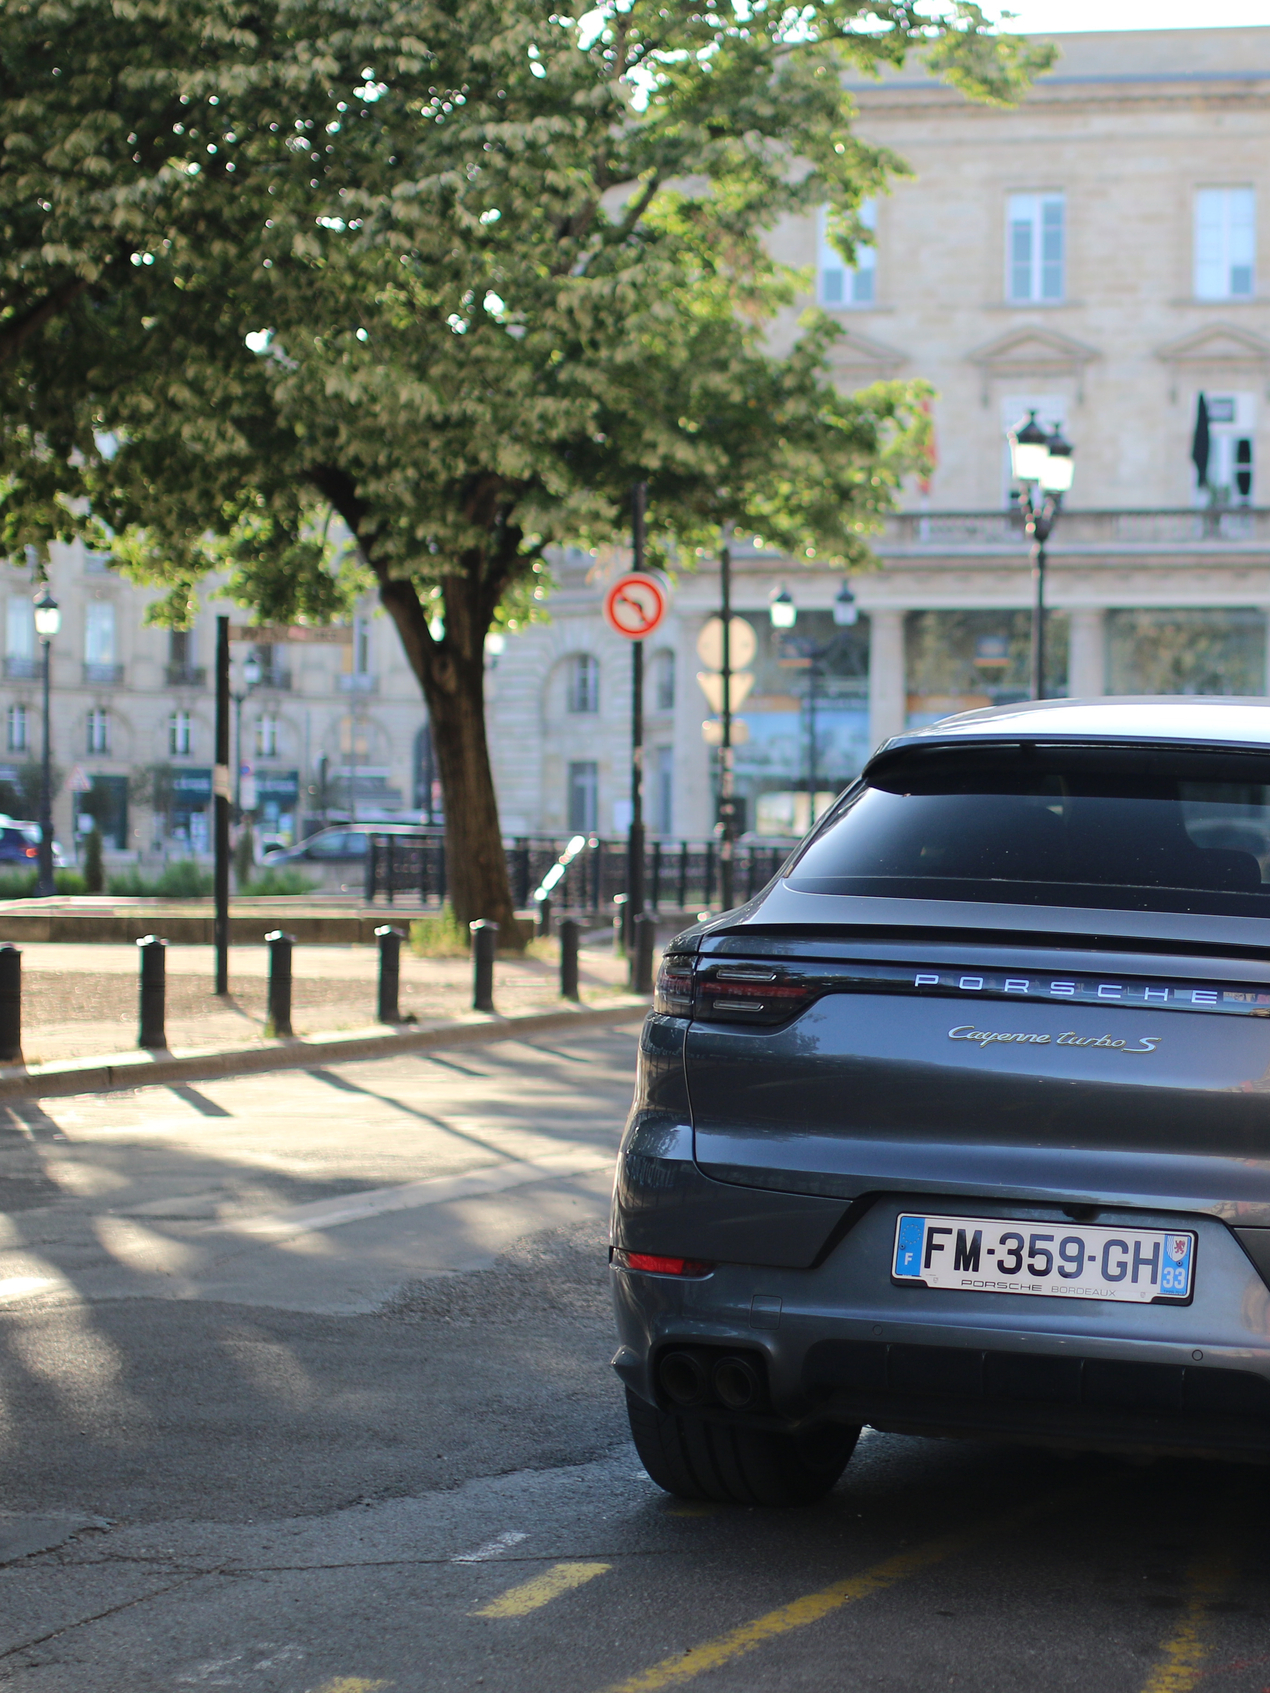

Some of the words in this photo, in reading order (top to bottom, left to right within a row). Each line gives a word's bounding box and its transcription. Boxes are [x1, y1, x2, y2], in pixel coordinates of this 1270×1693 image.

[914, 974, 1218, 1004] PORSCHE
[948, 1025, 1051, 1048] Cayenne
[1121, 1037, 1161, 1053] S
[904, 1252, 914, 1266] F
[924, 1226, 1161, 1285] FM-359-GH
[961, 1280, 1042, 1292] PORSCHE
[1051, 1285, 1116, 1297] BORDEAUX
[1162, 1267, 1186, 1289] 33
